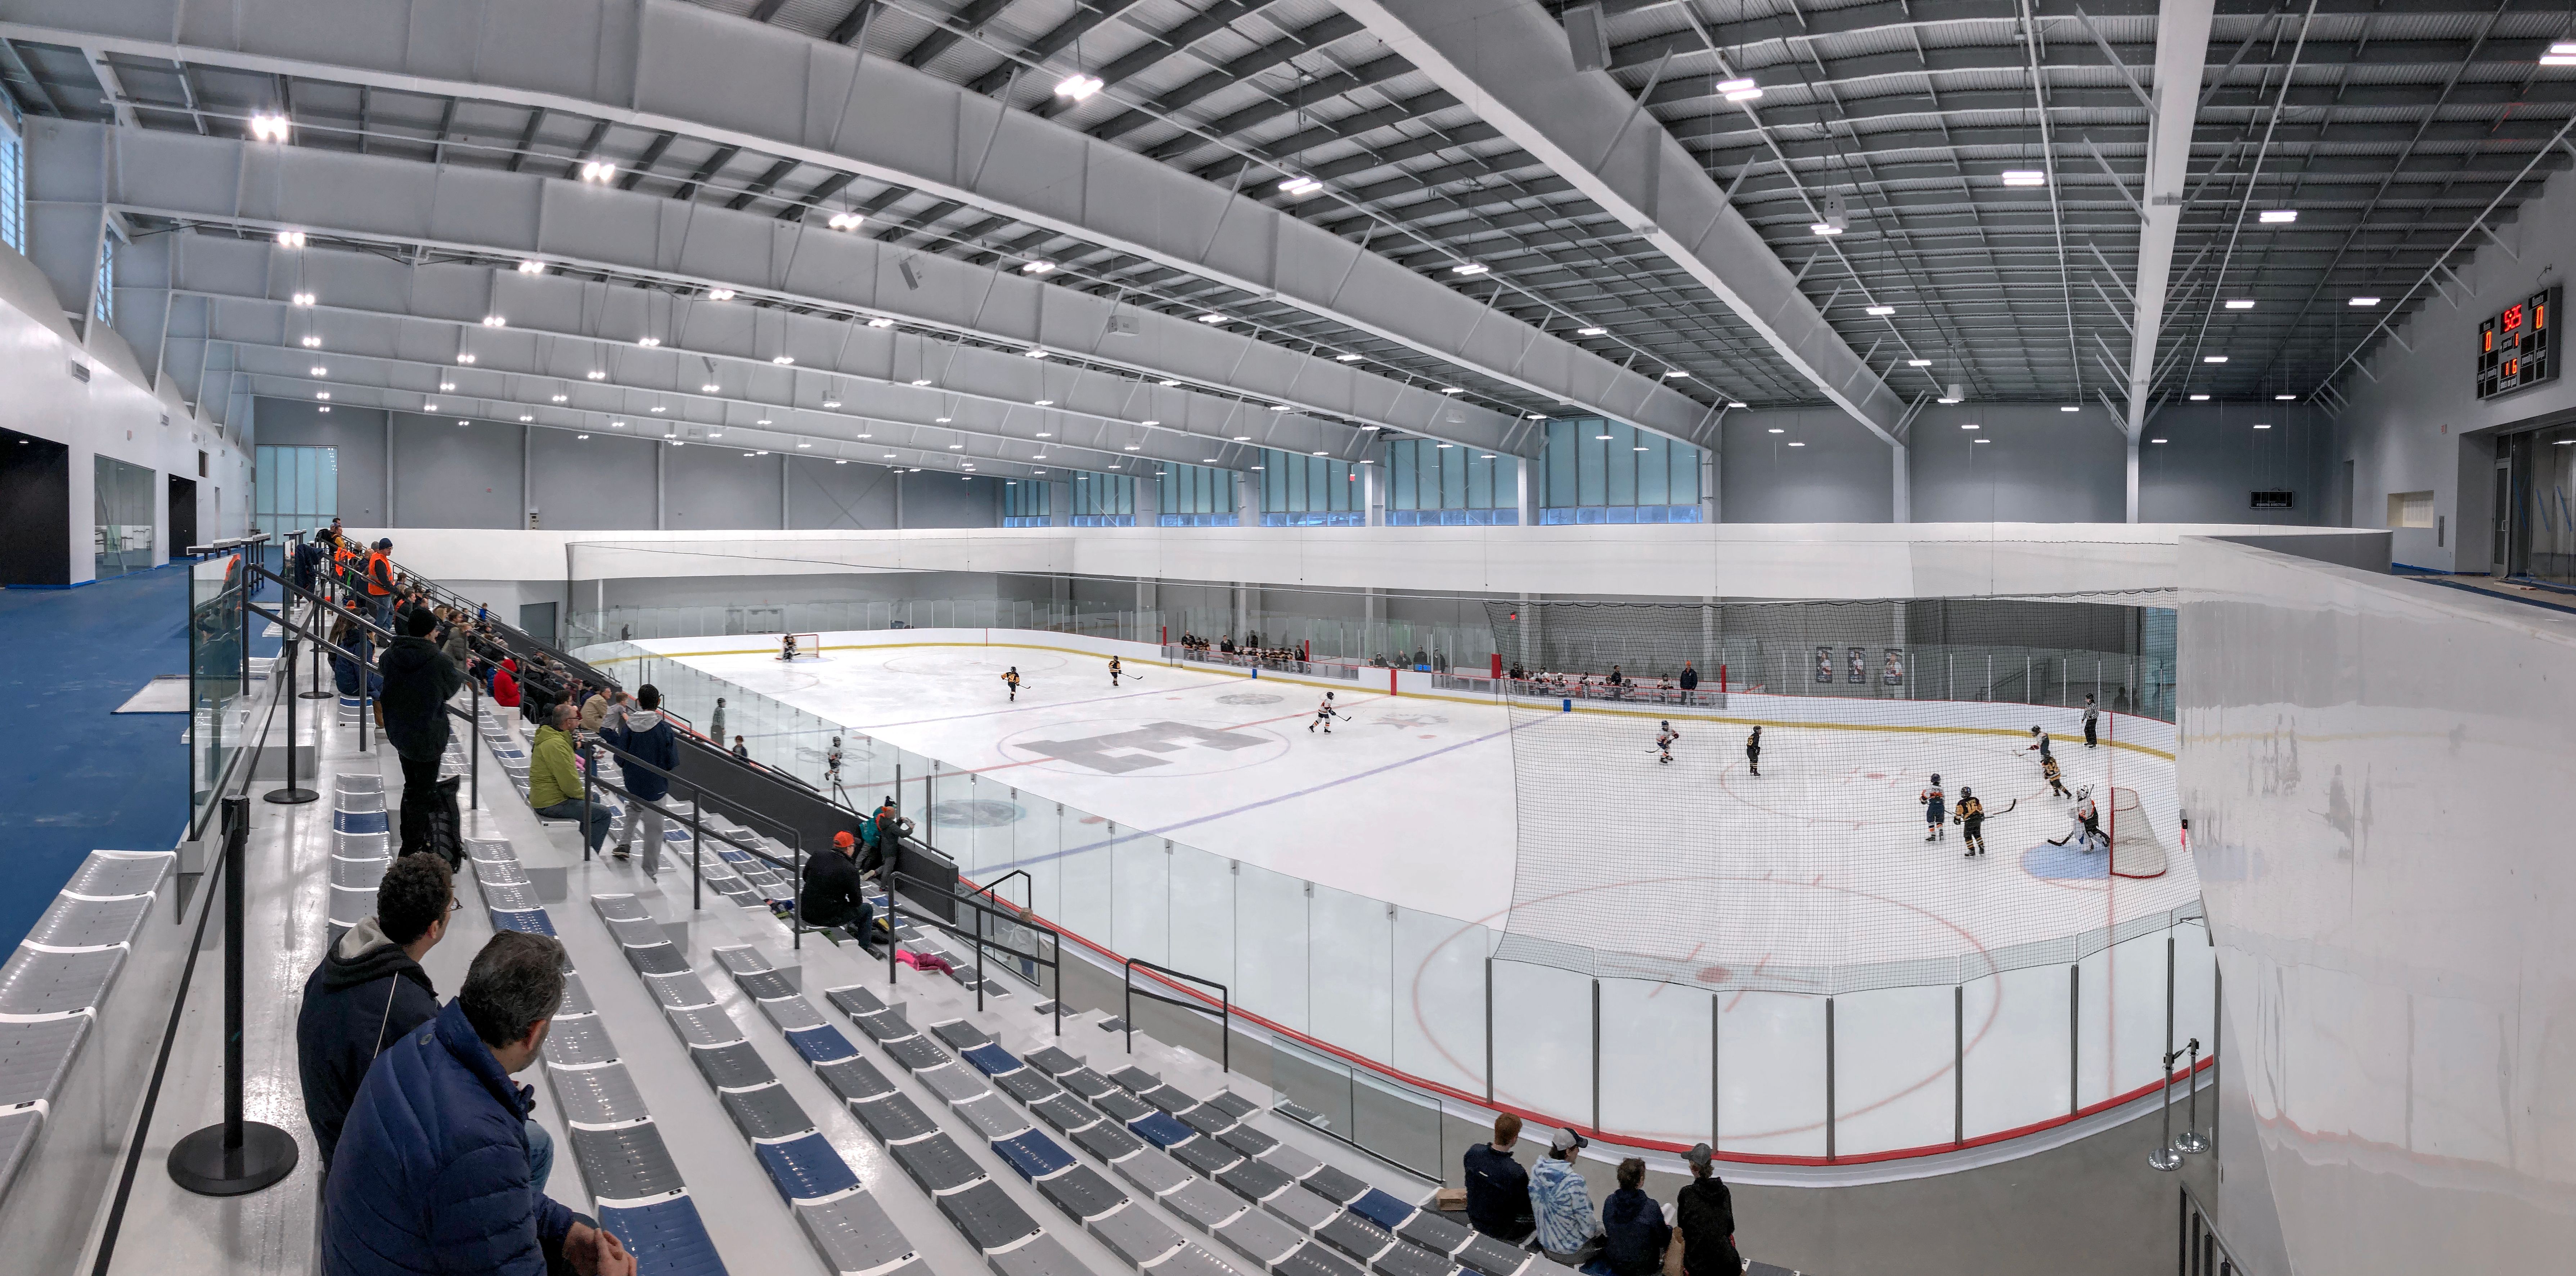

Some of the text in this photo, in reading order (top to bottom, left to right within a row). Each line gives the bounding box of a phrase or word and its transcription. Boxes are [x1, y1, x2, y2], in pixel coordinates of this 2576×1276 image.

[2536, 305, 2544, 329] 0
[2486, 331, 2492, 351] 0
[2515, 333, 2519, 347] 1
[2505, 358, 2517, 376] 16
